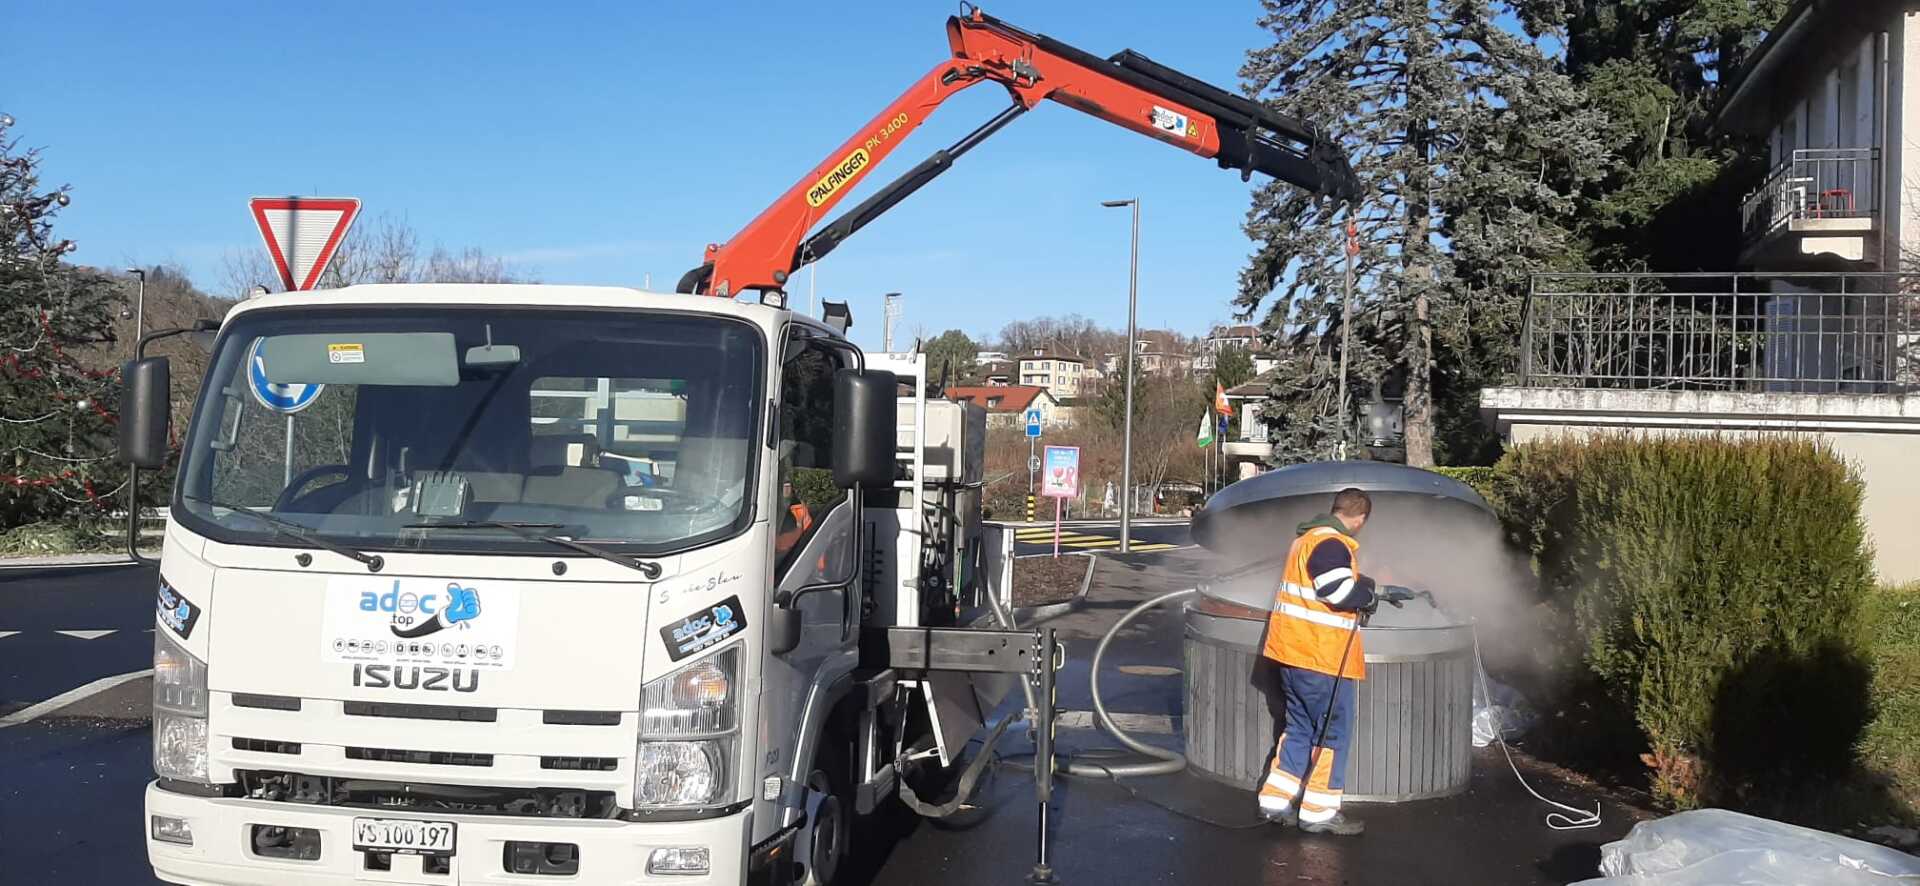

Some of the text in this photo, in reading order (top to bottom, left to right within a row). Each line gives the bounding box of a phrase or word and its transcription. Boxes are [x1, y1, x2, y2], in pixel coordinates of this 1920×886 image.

[809, 112, 909, 204] PALFINGER PK 3400
[360, 579, 437, 614] adoc
[353, 663, 480, 693] ISUZU
[358, 823, 449, 847] VS 100 197
